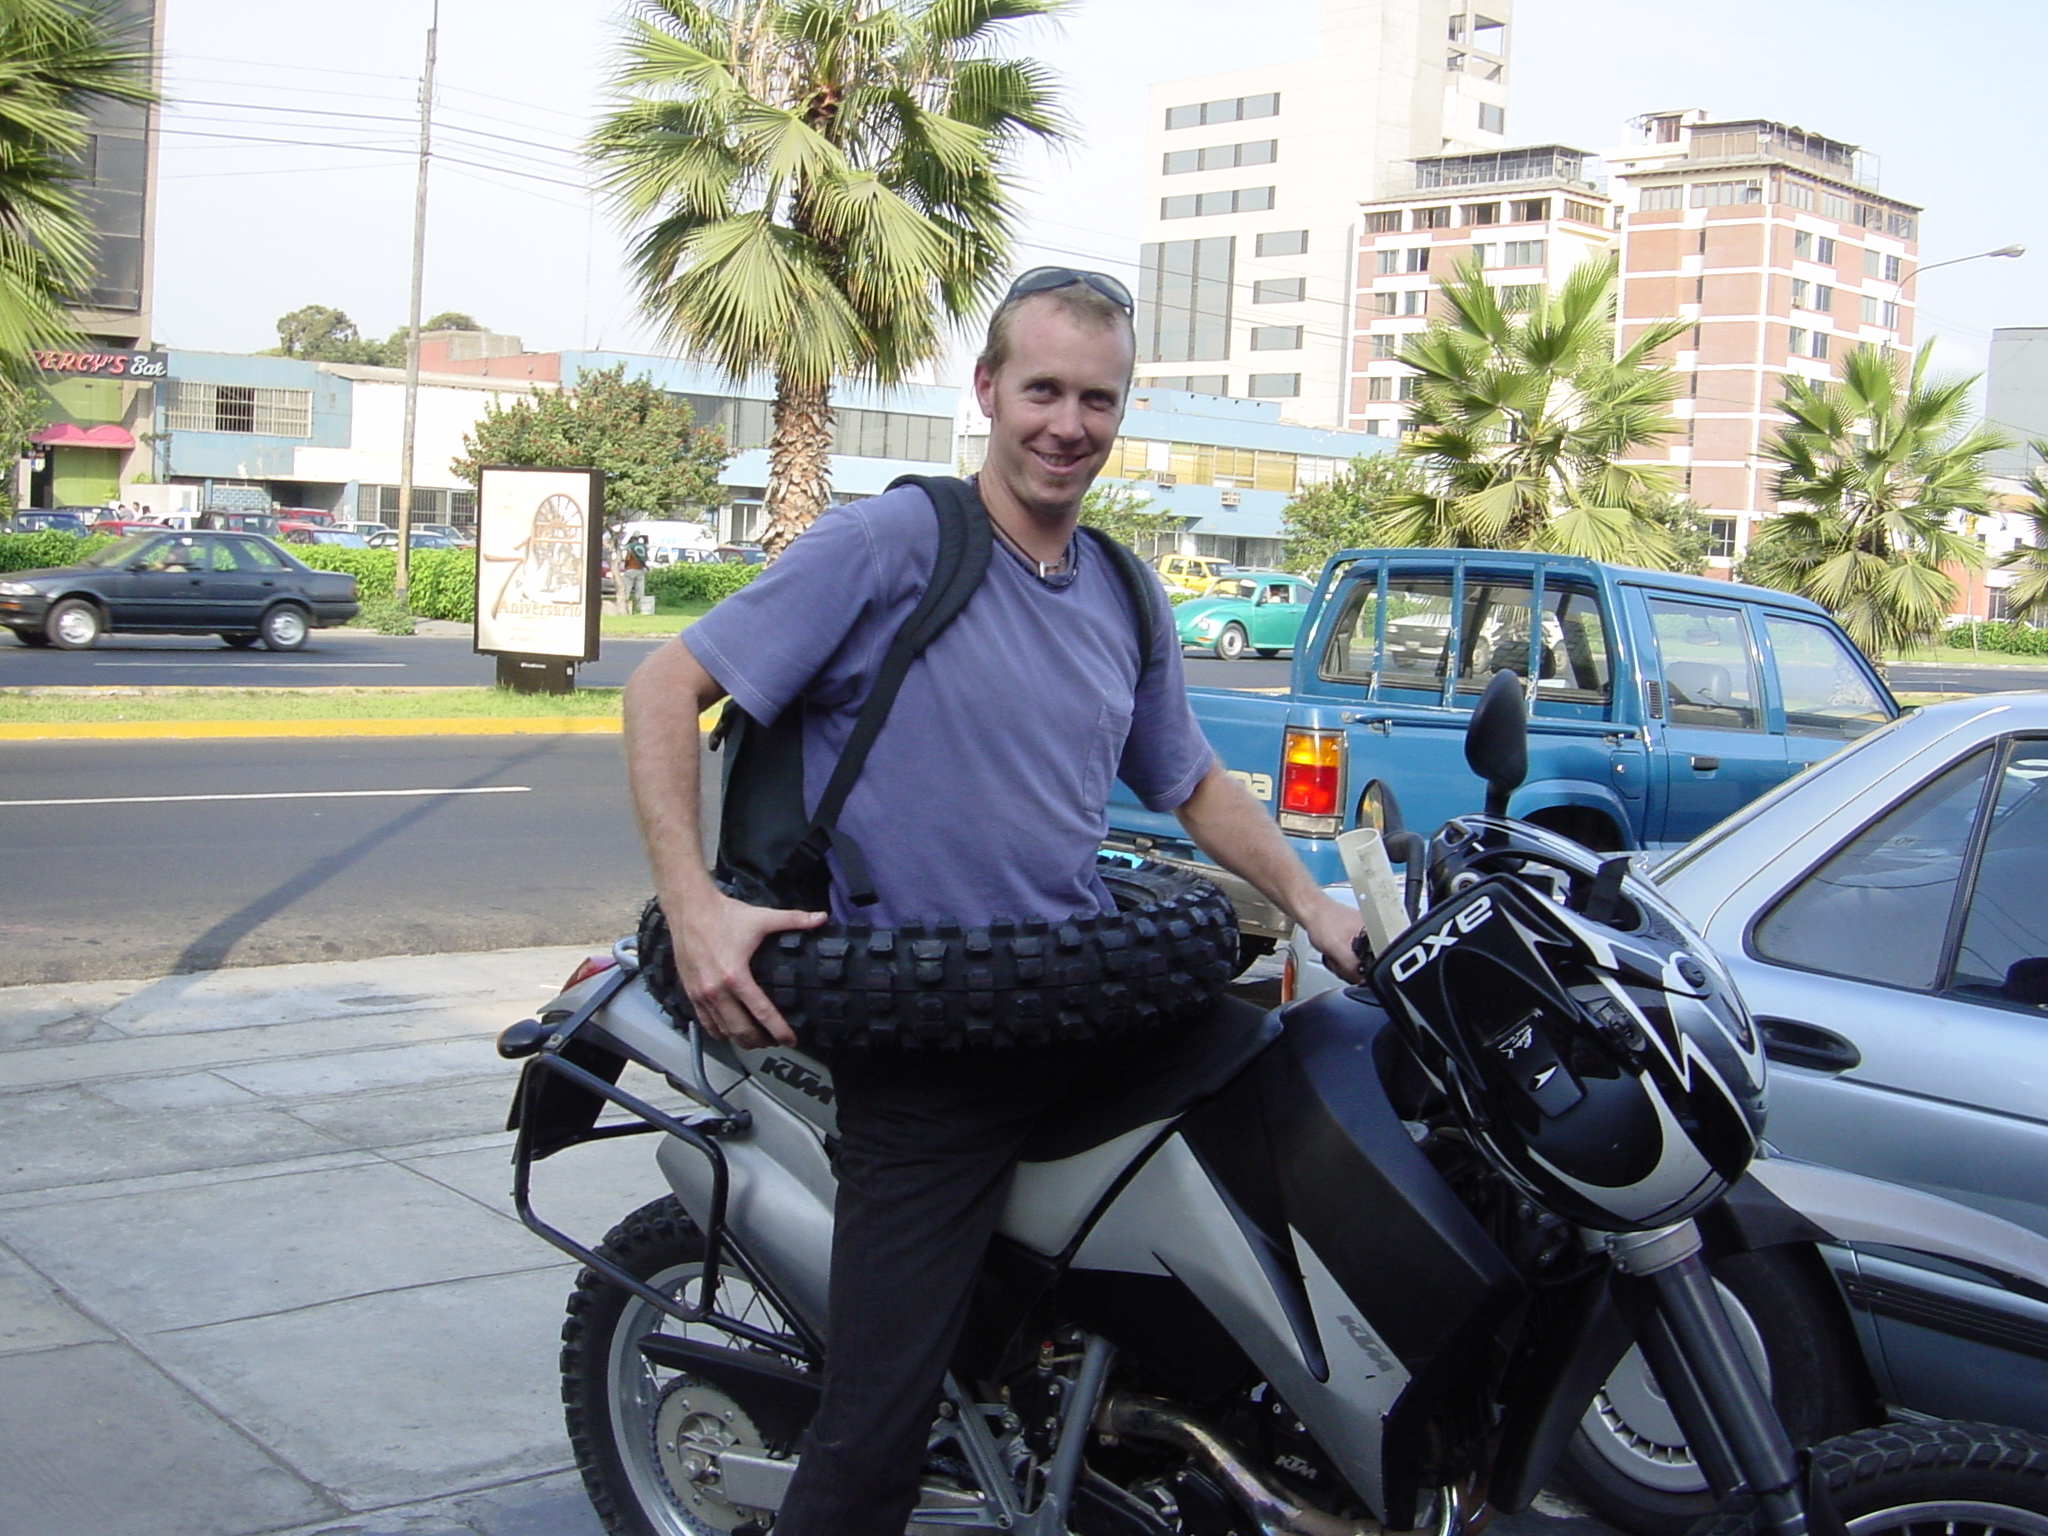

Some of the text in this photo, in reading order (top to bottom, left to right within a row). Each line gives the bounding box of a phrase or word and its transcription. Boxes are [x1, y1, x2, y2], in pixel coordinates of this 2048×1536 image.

[130, 355, 167, 377] Bar
[497, 599, 582, 617] Aniversario
[759, 1056, 835, 1106] KTM
[1336, 1314, 1396, 1373] KTM
[1274, 1454, 1318, 1480] KTM
